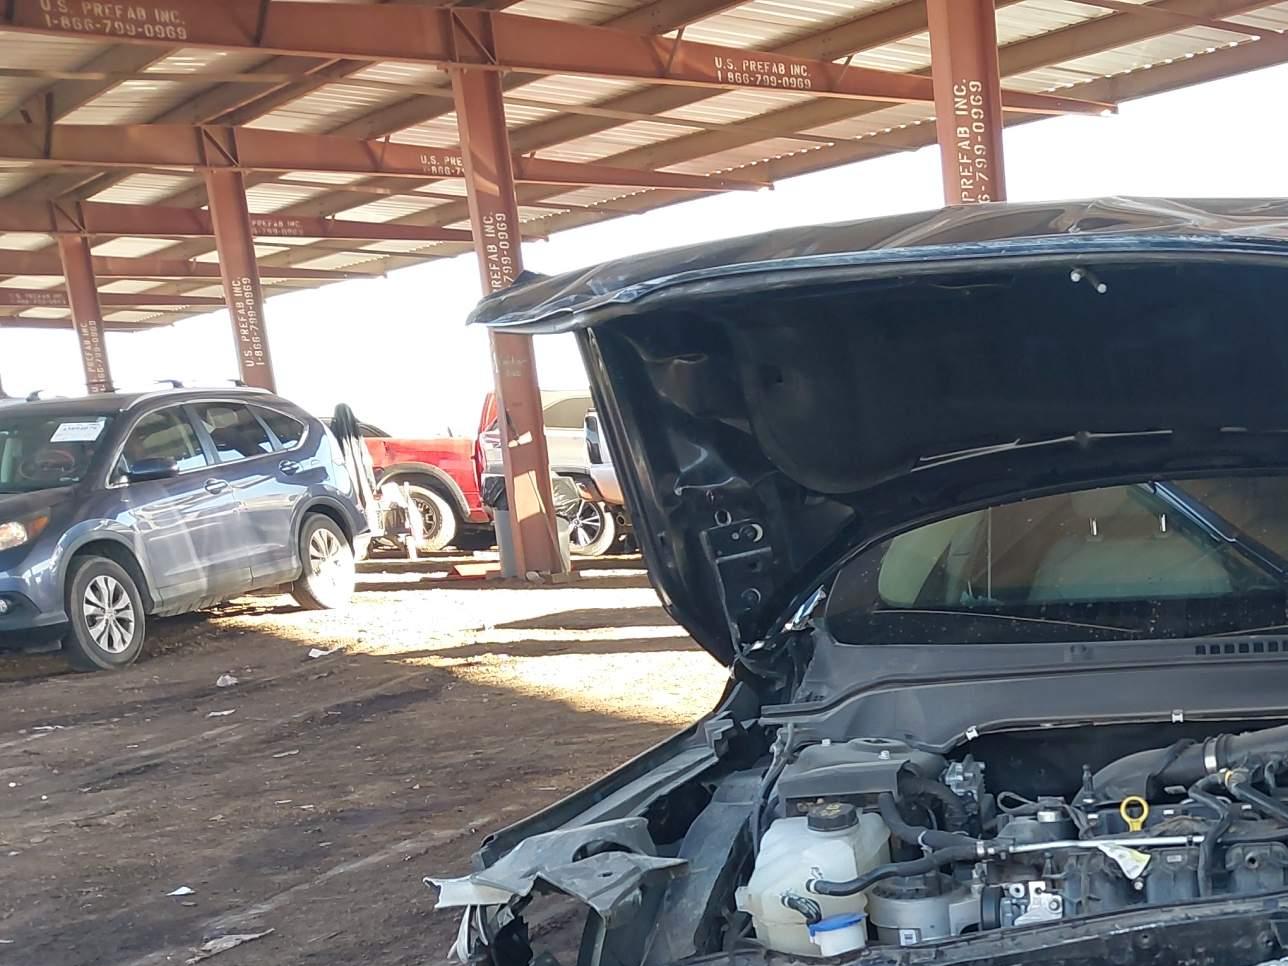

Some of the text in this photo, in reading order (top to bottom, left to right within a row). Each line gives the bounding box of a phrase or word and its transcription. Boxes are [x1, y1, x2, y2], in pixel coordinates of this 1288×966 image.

[81, 2, 147, 21] PREFAB
[154, 9, 186, 25] INC.
[45, 14, 188, 40] 1-866-799-0969
[714, 56, 812, 77] U.S. PREFAB INC.
[953, 79, 976, 202] PREFAB INC.
[420, 155, 440, 166] U.S.
[483, 211, 496, 237] INC.
[232, 276, 255, 367] U.S. PREFAB INC.
